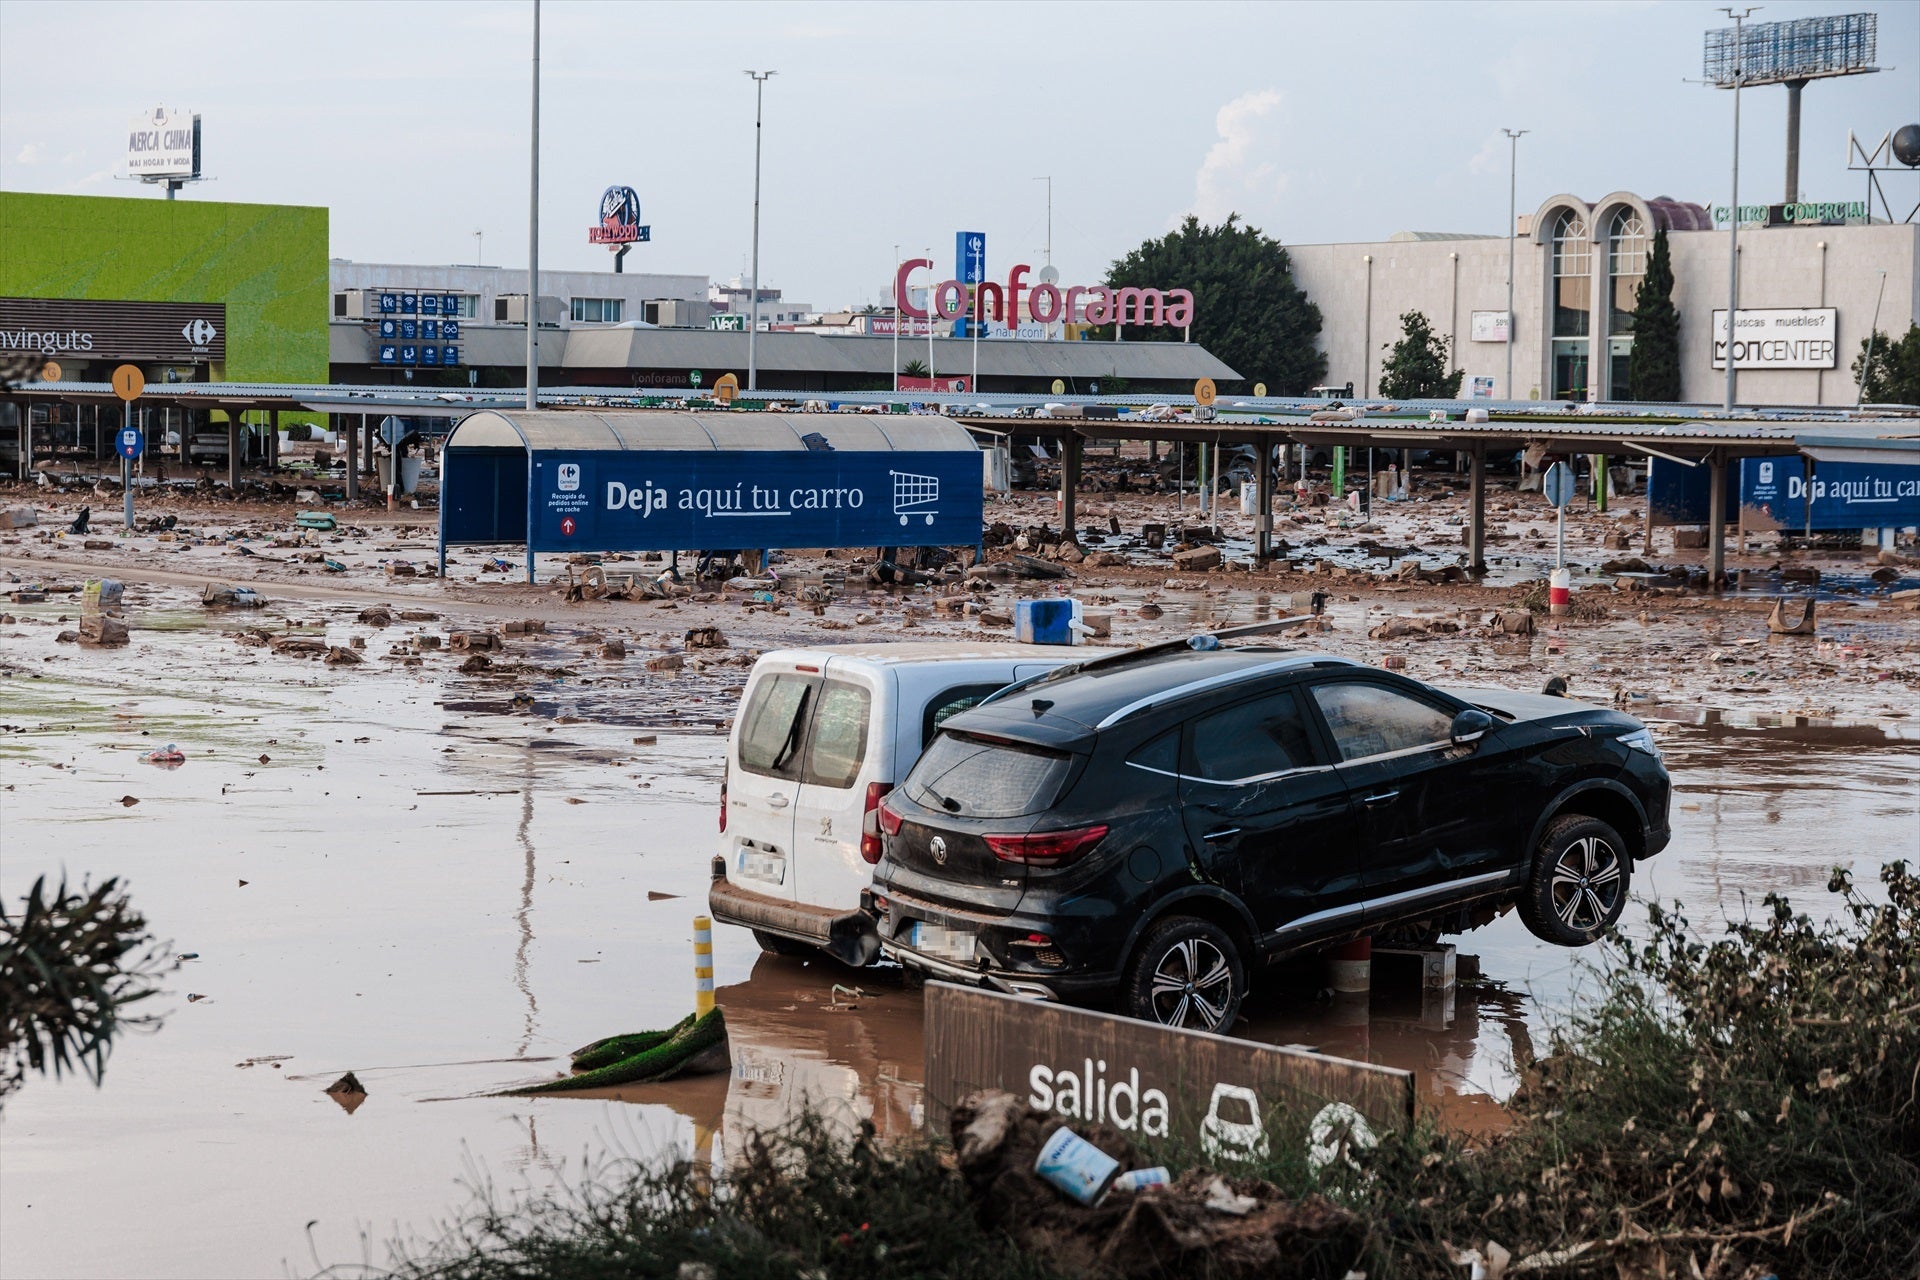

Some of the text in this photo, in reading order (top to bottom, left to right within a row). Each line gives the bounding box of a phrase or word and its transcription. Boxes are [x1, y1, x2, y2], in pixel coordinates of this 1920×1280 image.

[129, 130, 191, 152] MERCA CHINA
[167, 157, 172, 166] Y
[1783, 202, 1868, 221] COMERCIAL
[893, 258, 1193, 328] Conforama
[1775, 315, 1826, 327] muebles?
[1201, 385, 1210, 399] G
[607, 480, 864, 518] Deja aquí tu carro
[1788, 475, 1826, 504] Deja
[1829, 476, 1869, 504] aquí
[1873, 478, 1892, 497] tu
[1029, 1058, 1169, 1138] salida
